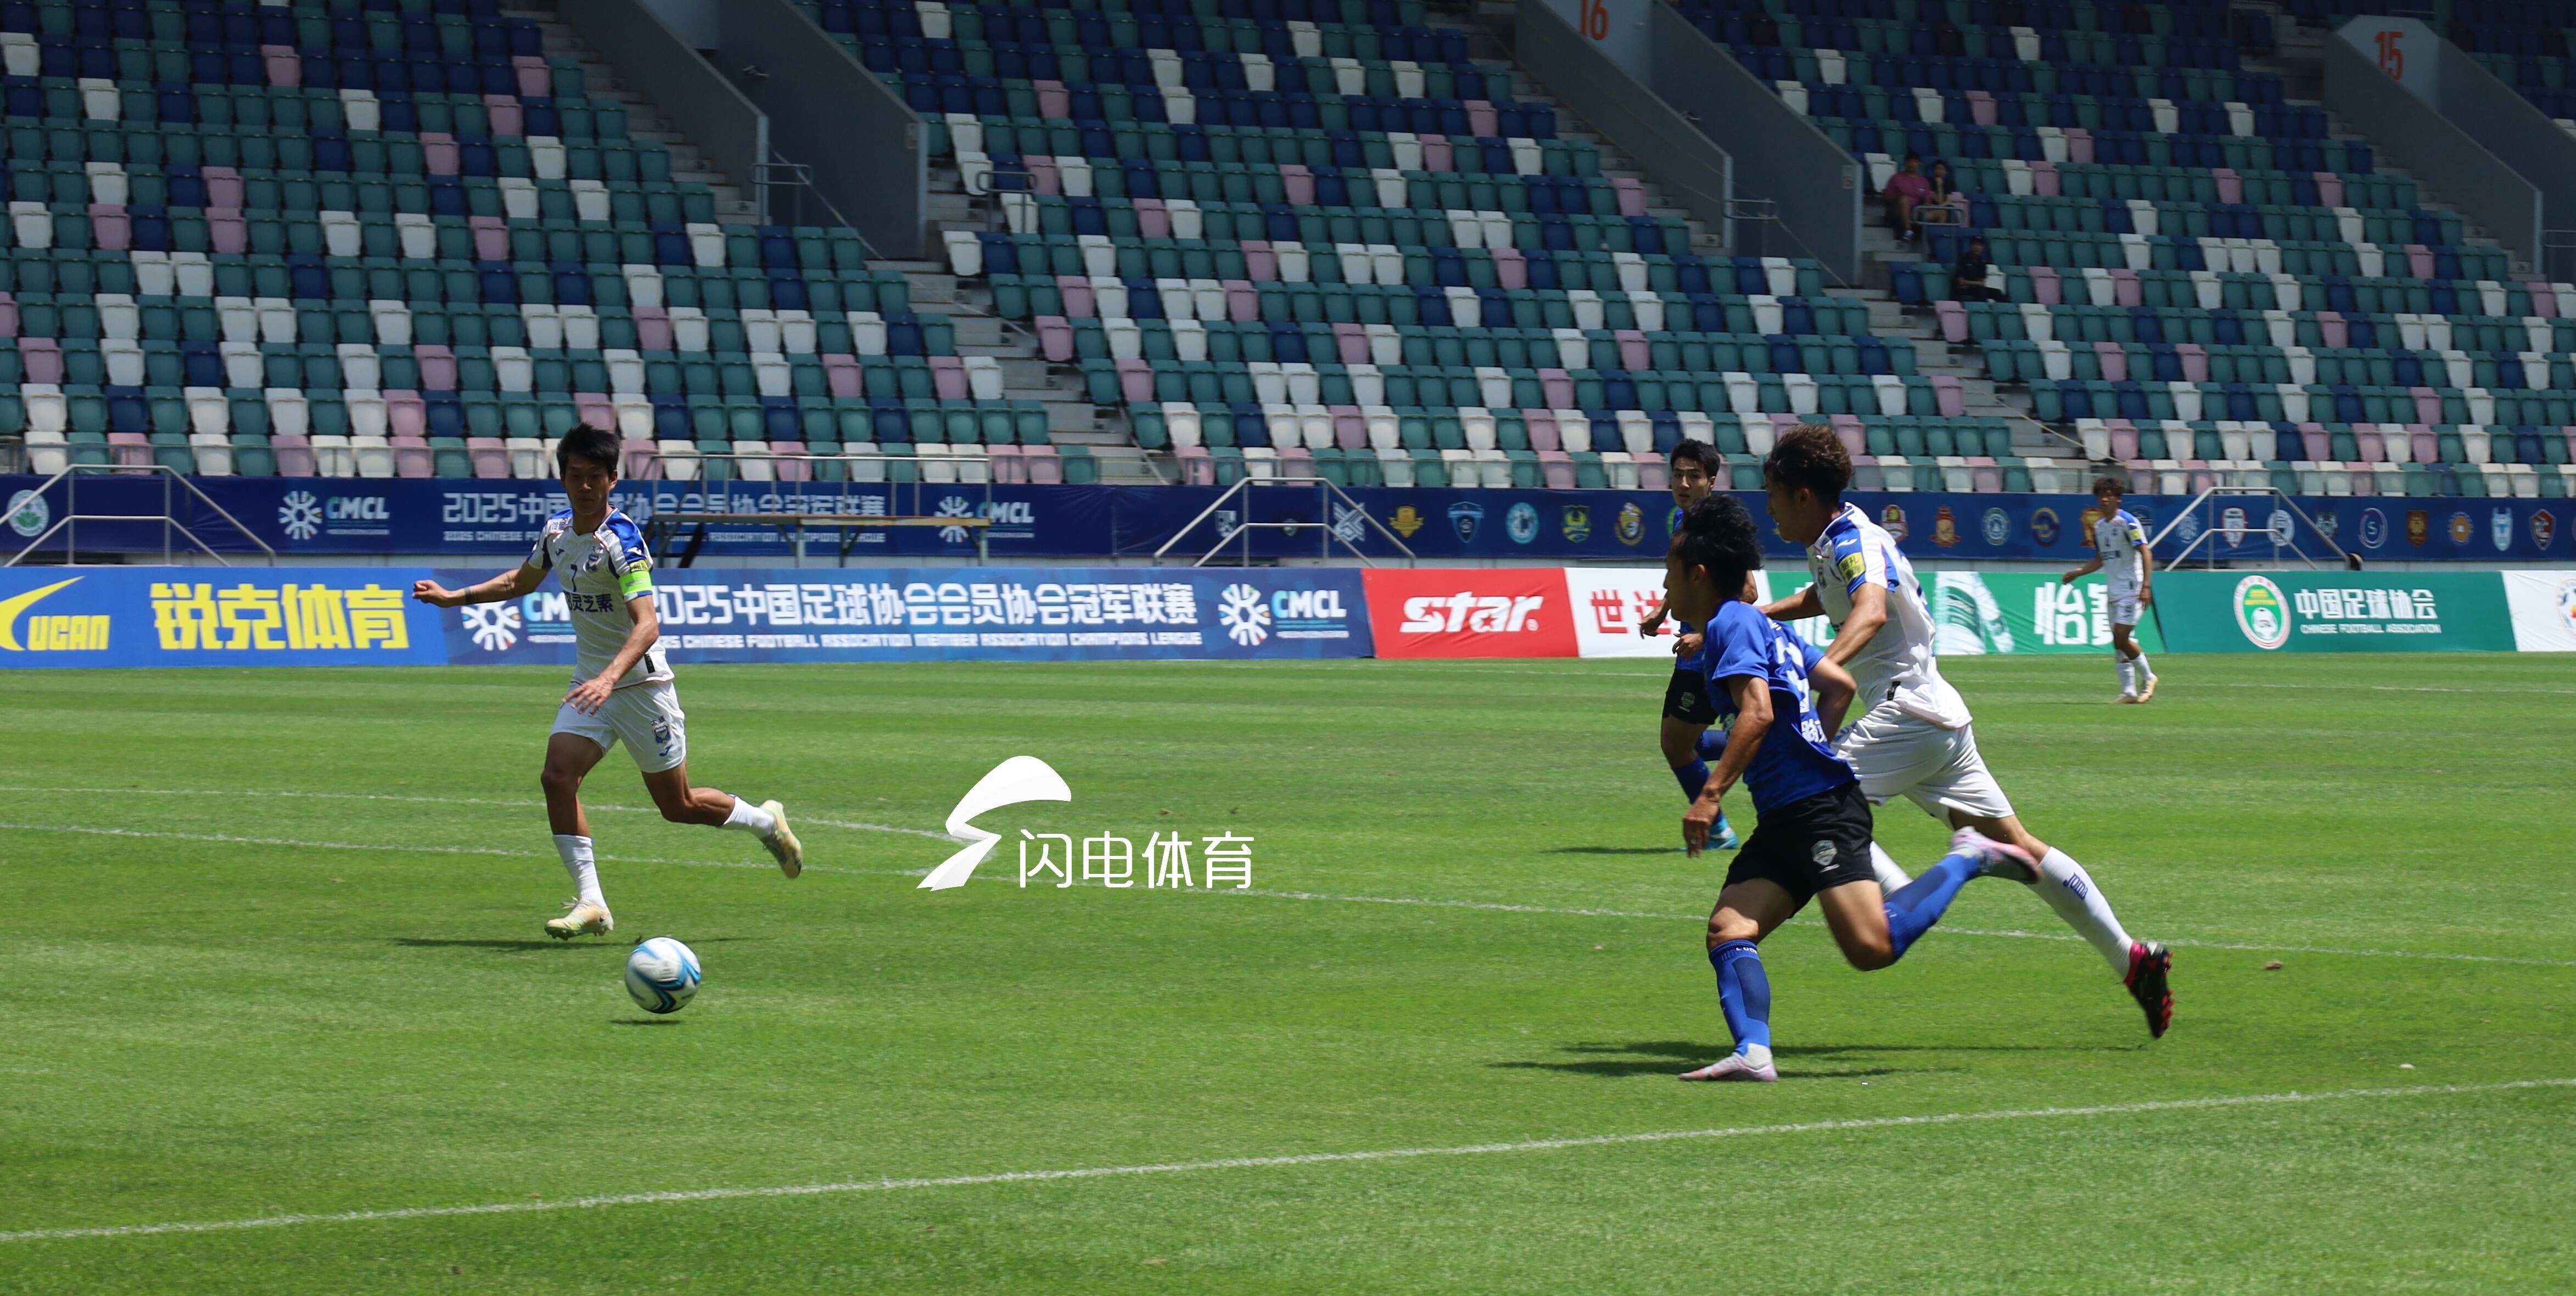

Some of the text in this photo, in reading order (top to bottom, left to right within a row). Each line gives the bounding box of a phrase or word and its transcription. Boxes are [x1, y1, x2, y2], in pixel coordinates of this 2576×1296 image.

[1580, 0, 1609, 41] 16
[2375, 31, 2405, 80] 15
[325, 496, 390, 520] CMCL
[975, 502, 1035, 523] CMCL
[571, 564, 578, 592] 7
[150, 583, 410, 649] 锐克体育
[523, 591, 570, 621] CM
[1272, 590, 1347, 618] CMCL
[2293, 588, 2438, 619] 中国足球协会
[682, 635, 745, 648] CHINESE
[746, 634, 820, 648] FOOTBALL
[820, 633, 913, 647] ASSOCIATION
[979, 633, 1068, 646] ASSOCIATION
[1069, 632, 1150, 646] CHAMPIONS
[1150, 632, 1203, 645] LEAGUE
[2300, 624, 2442, 634] CHINESE FOOTBALL ASSOCIATION
